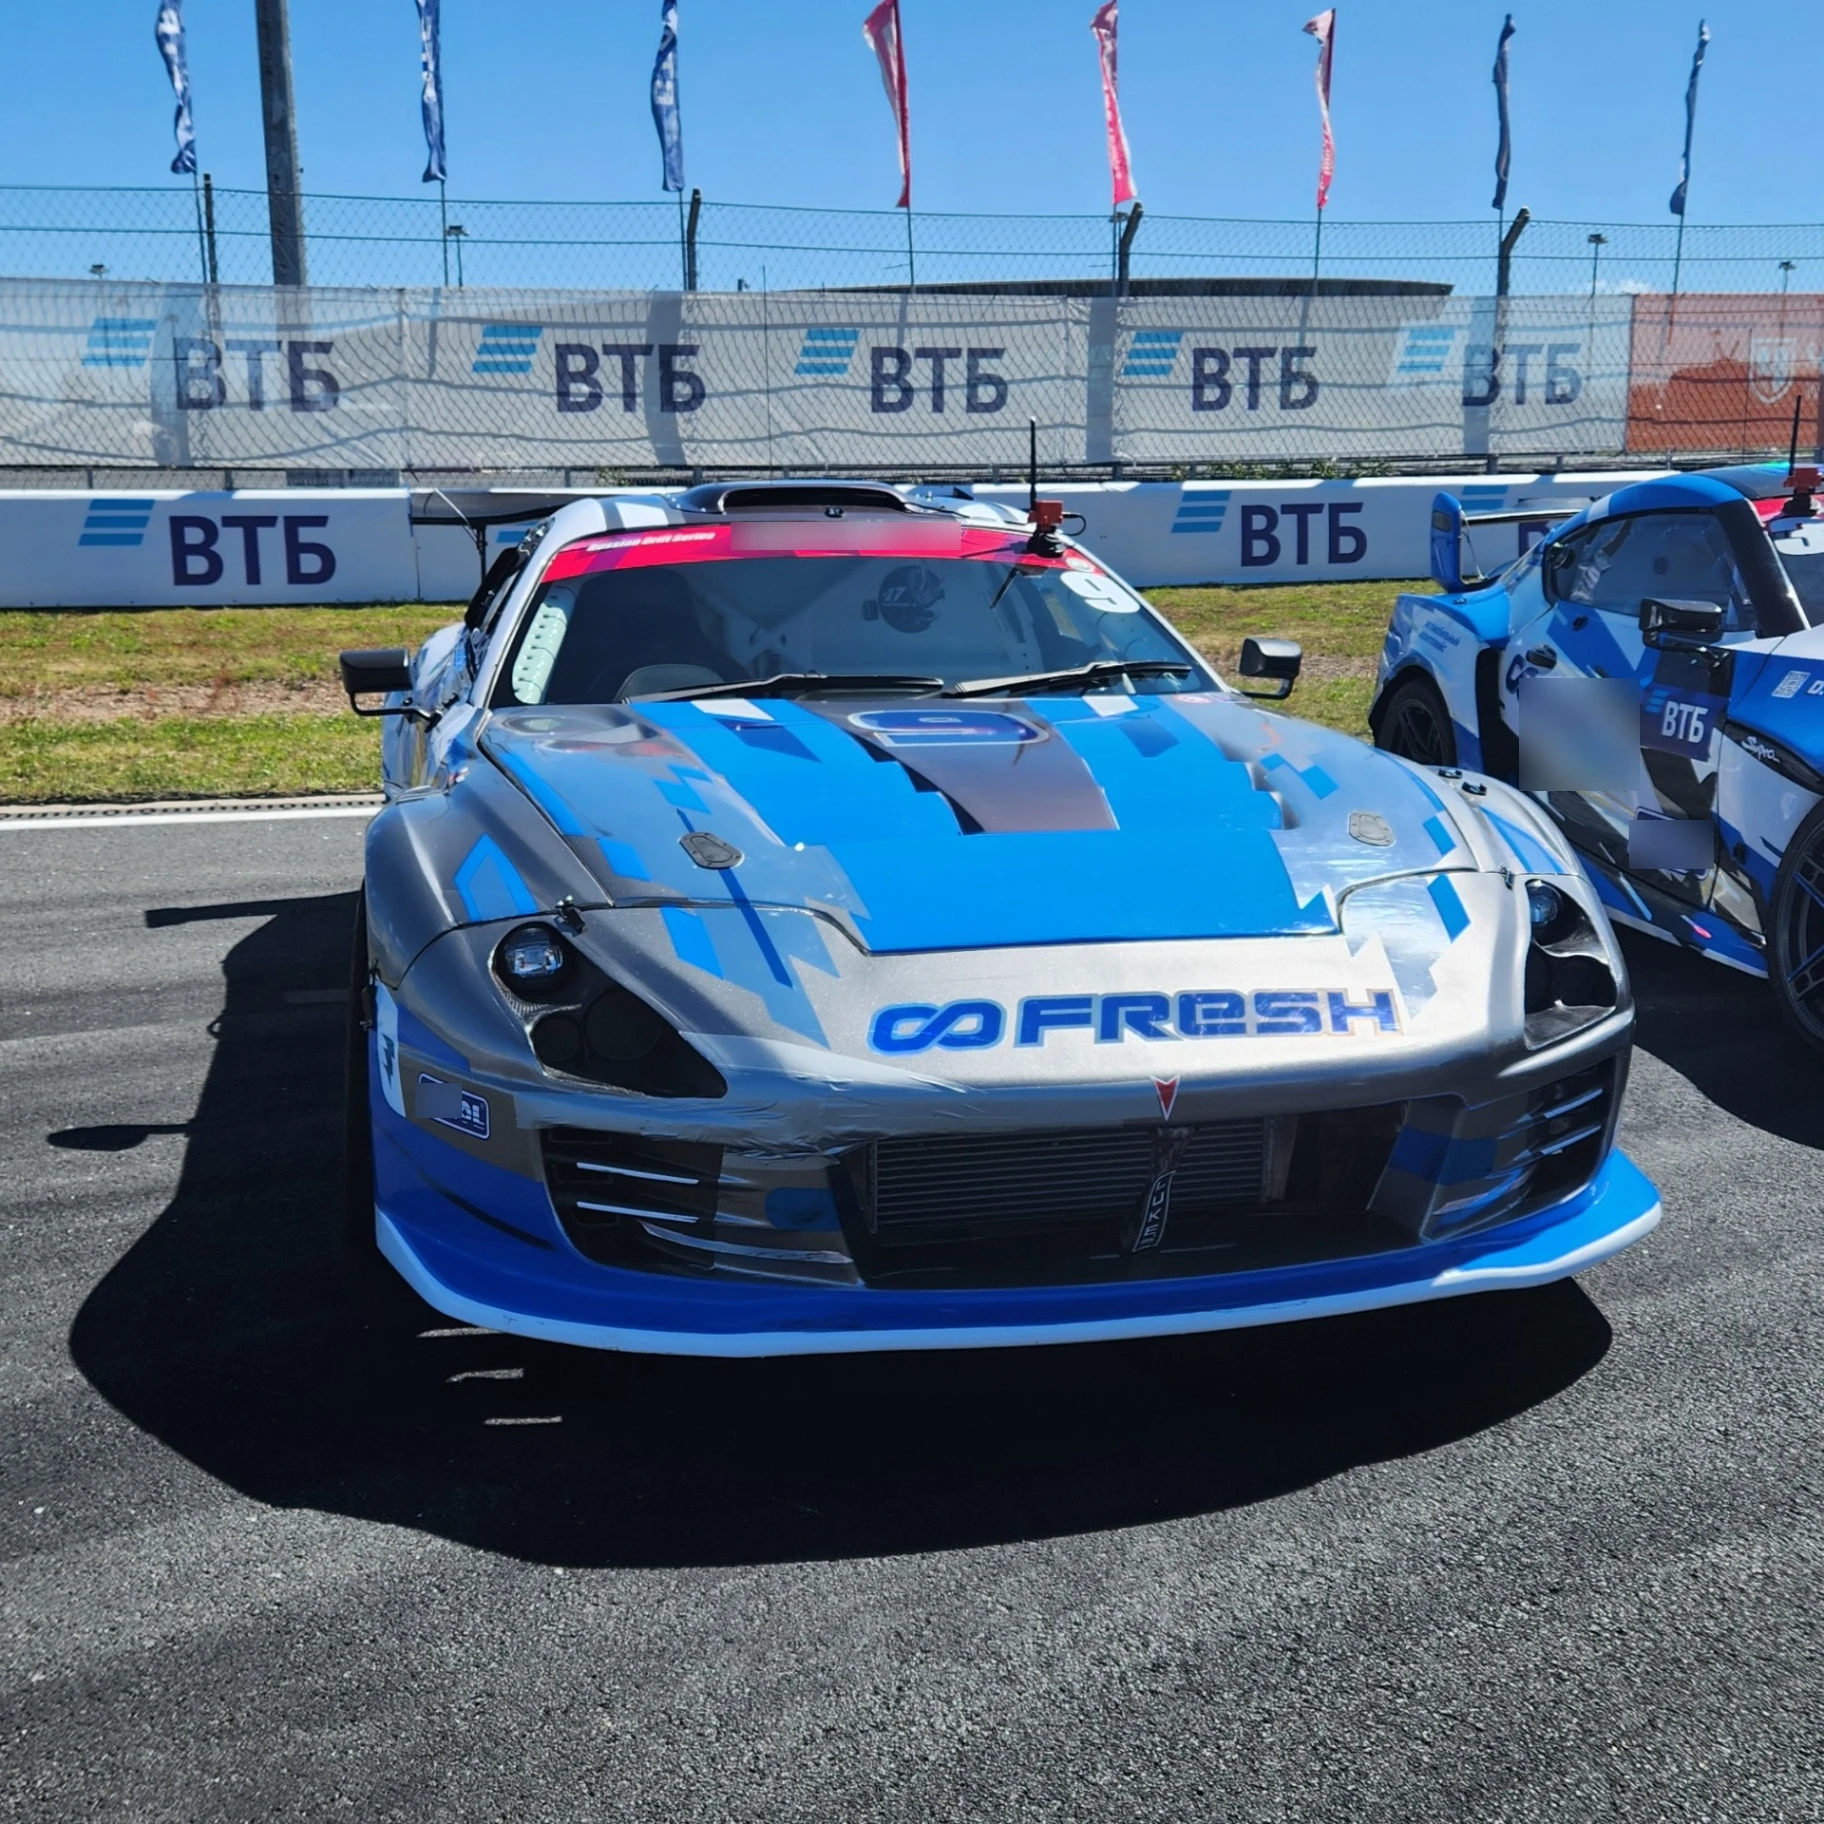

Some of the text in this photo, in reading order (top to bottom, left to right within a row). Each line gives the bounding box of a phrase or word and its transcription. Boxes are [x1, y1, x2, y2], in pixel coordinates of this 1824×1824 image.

[172, 337, 341, 413] ВТБ
[555, 343, 706, 413] ВТБ
[870, 347, 1009, 414] ВТБ
[1192, 346, 1319, 412] ВТБ
[1462, 343, 1582, 406] ВТБ
[168, 515, 336, 586] ВТБ
[1240, 502, 1368, 567] ВТБ
[1060, 571, 1140, 613] 9
[1661, 700, 1709, 744] ВТБ
